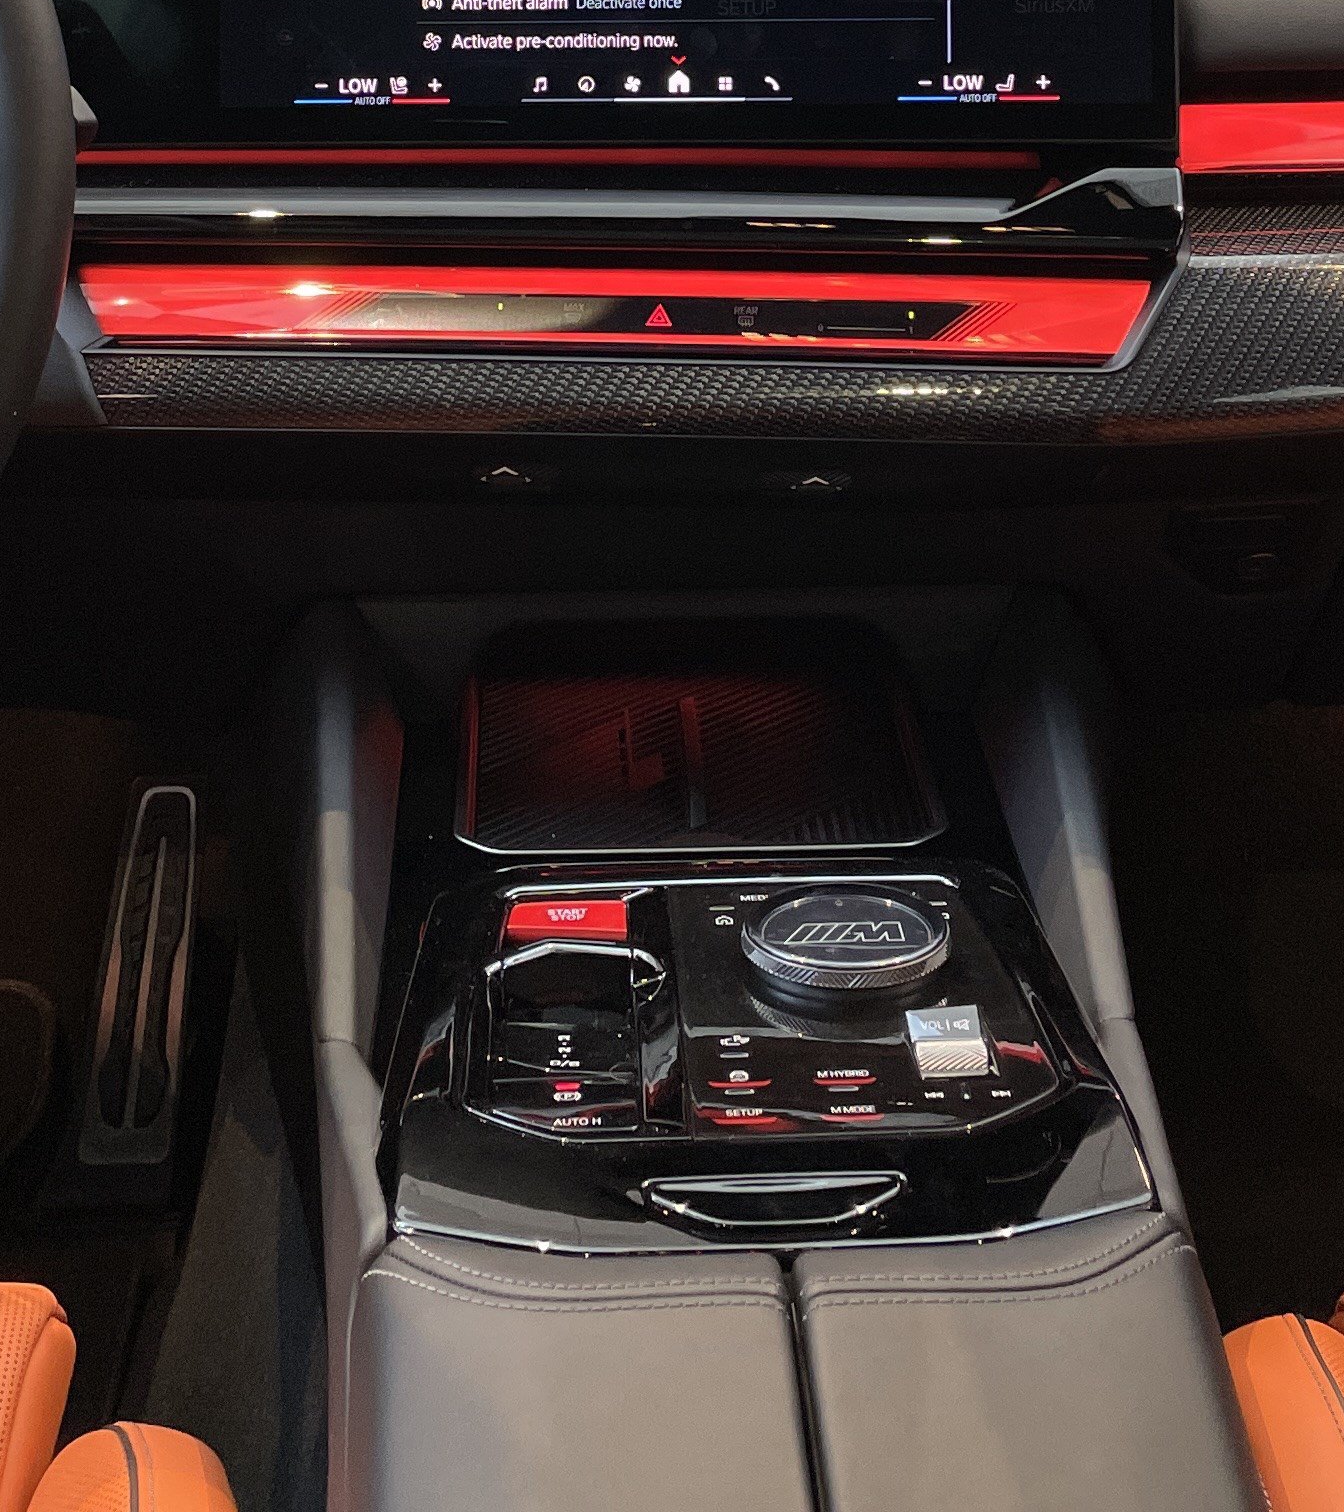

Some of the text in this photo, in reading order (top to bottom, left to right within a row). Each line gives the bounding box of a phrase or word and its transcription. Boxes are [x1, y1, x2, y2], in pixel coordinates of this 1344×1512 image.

[451, 33, 679, 52] Activate pre-conditioning now.
[338, 77, 378, 94] LOW
[942, 74, 984, 91] LOW
[354, 96, 391, 106] AUTO OFF
[959, 93, 997, 103] AUTO OFF
[734, 306, 758, 316] REAR
[547, 907, 588, 916] START
[551, 914, 585, 922] STOP
[920, 1019, 945, 1030] VOL
[816, 1068, 870, 1078] M HYBRID
[725, 1108, 763, 1117] SETUP
[830, 1104, 876, 1114] M MODE
[553, 1116, 602, 1127] AUTO H
